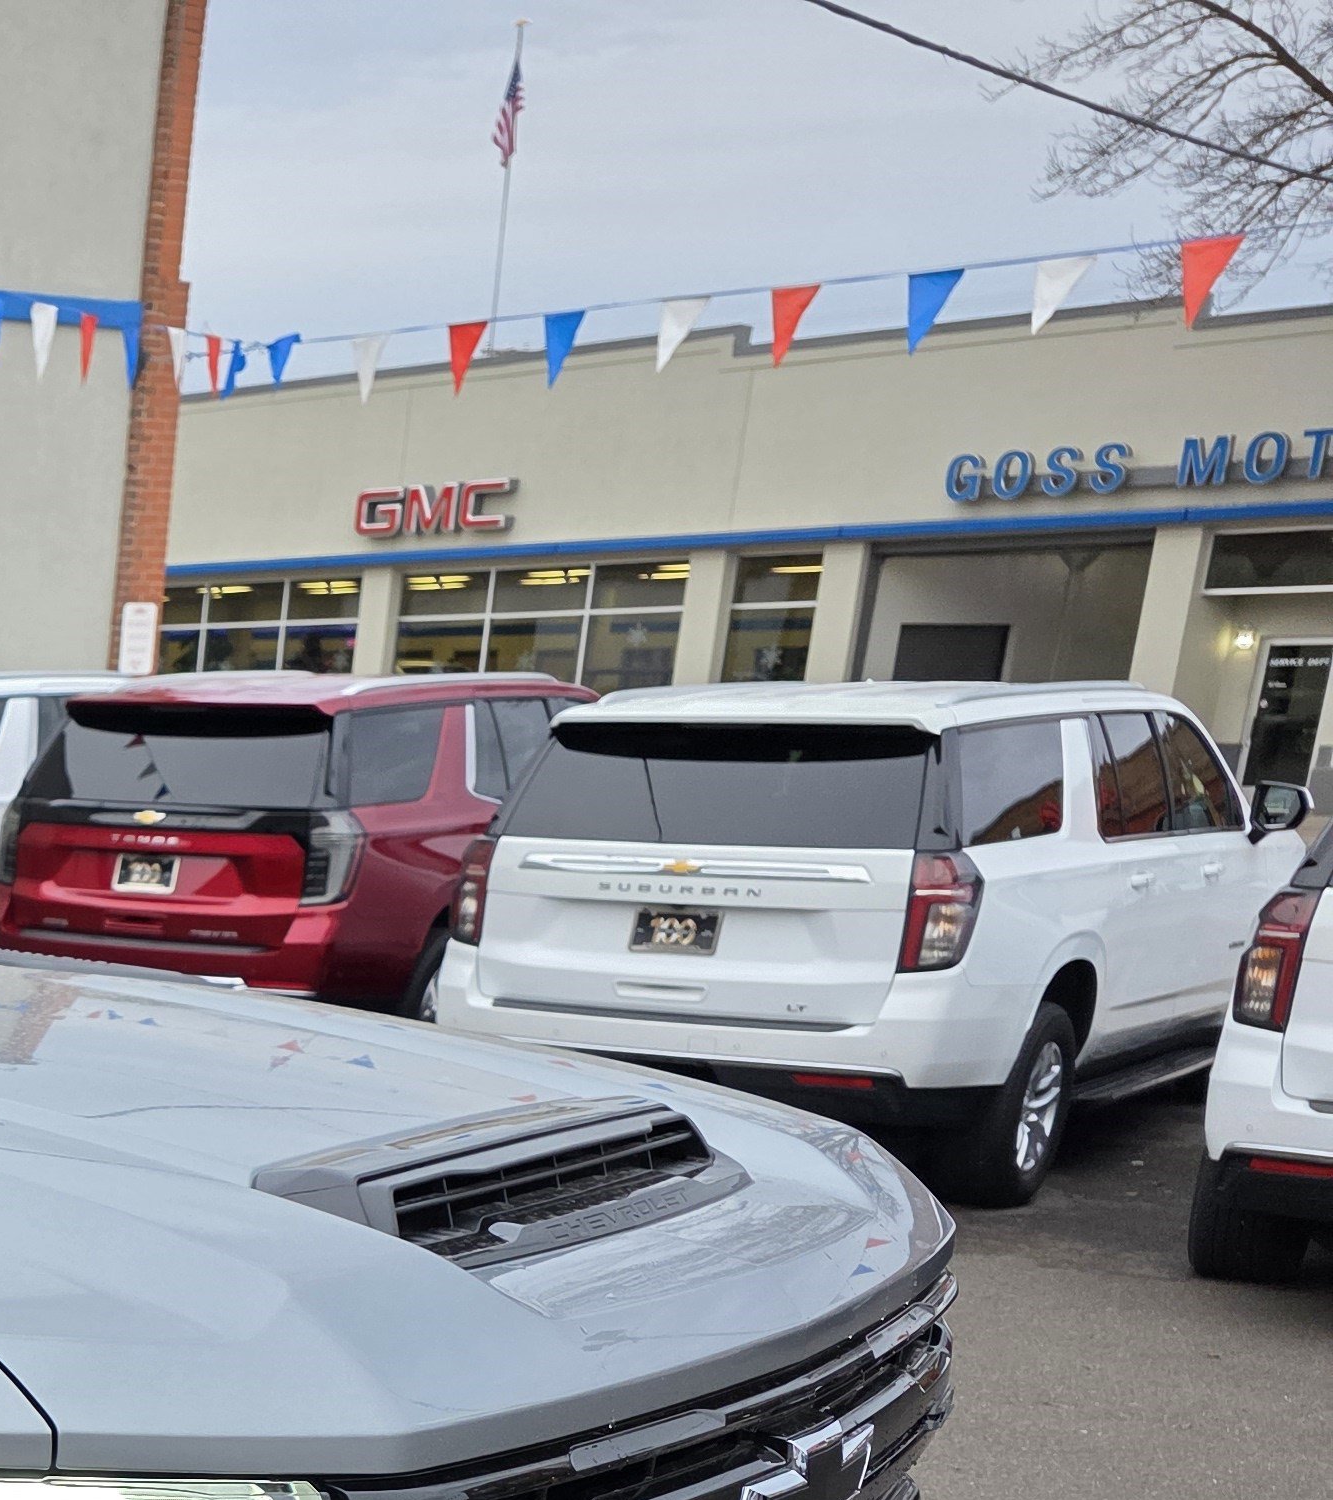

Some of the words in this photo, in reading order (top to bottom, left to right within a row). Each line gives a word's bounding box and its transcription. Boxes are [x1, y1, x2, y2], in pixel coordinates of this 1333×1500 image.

[944, 441, 1133, 503] GOSS
[353, 476, 518, 538] GMC
[598, 881, 763, 898] SUBURBAN
[786, 1003, 808, 1013] LT
[545, 1185, 690, 1242] CHEVROLET
